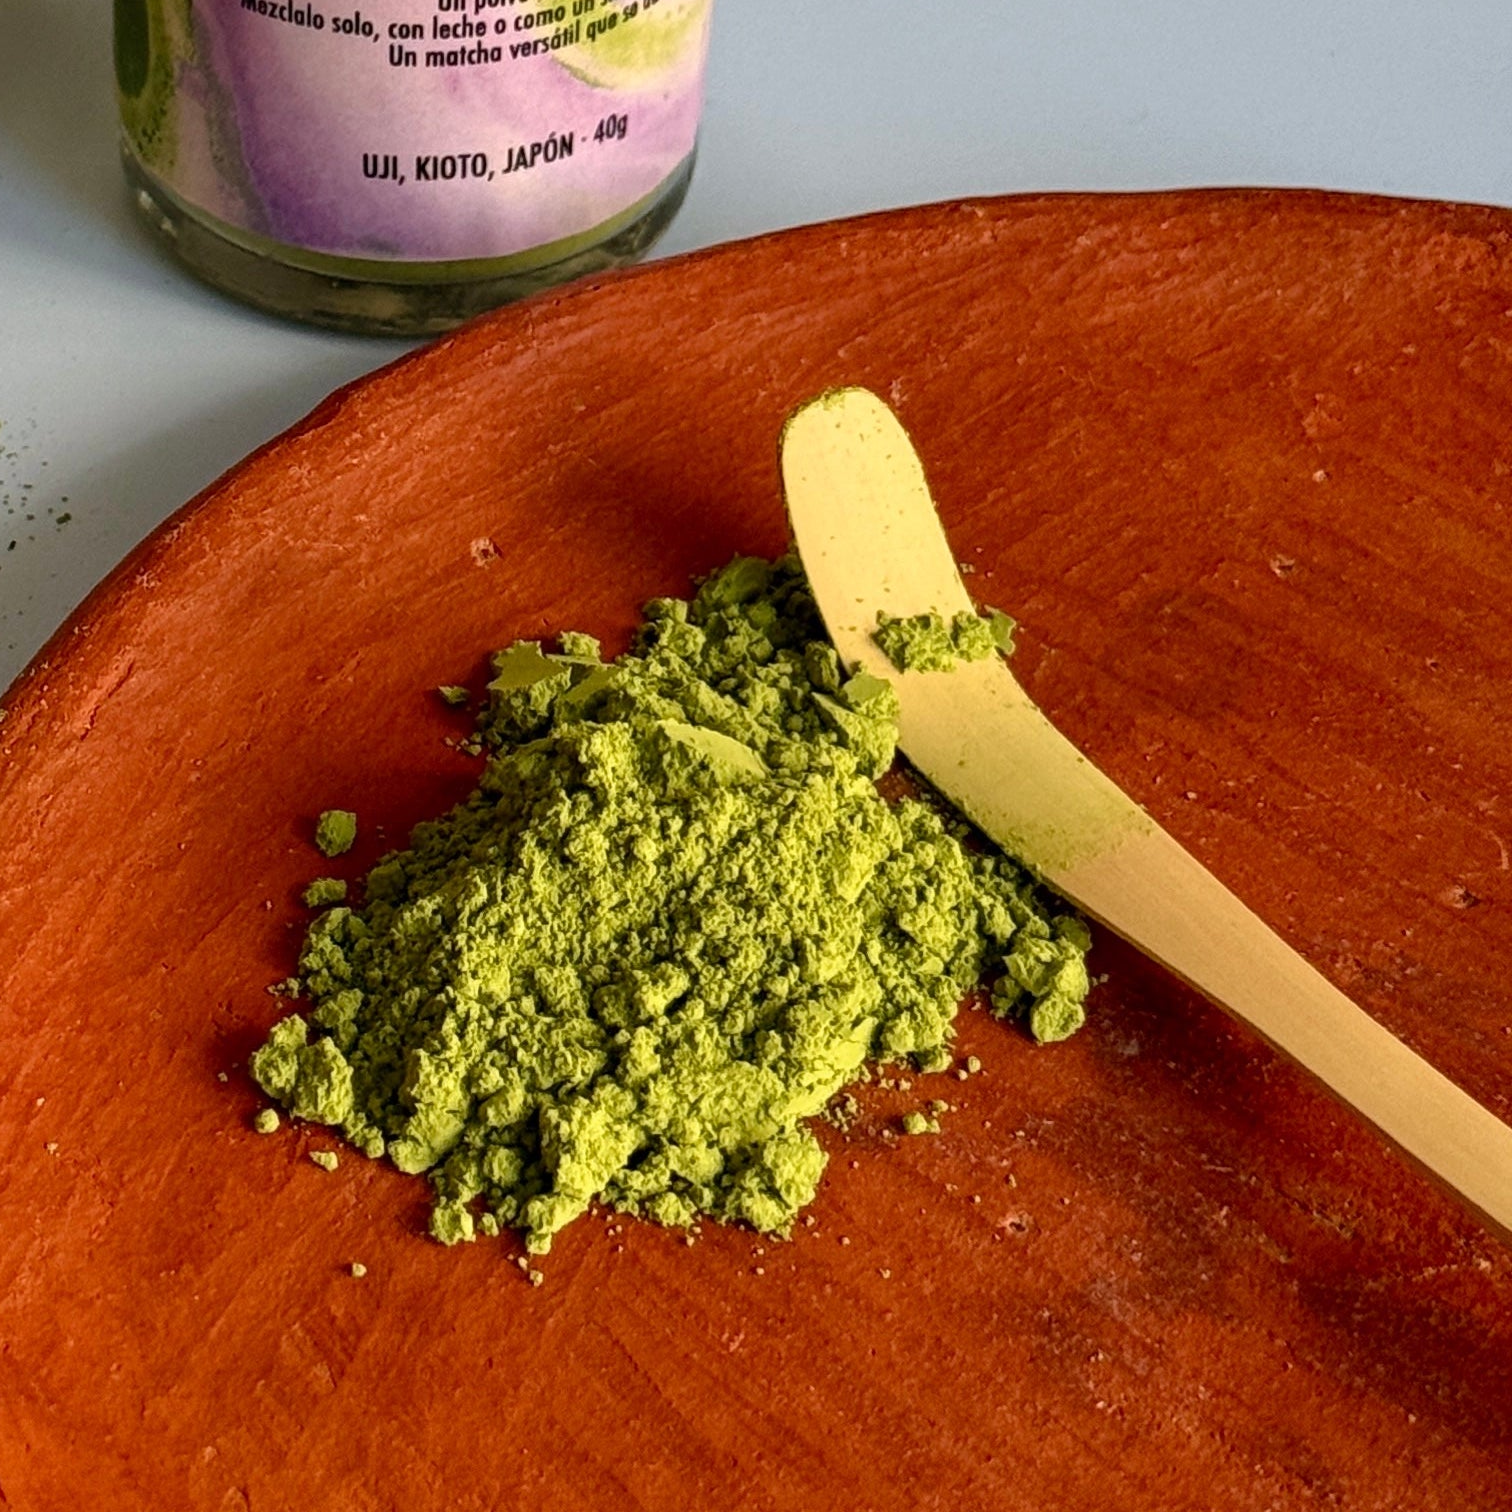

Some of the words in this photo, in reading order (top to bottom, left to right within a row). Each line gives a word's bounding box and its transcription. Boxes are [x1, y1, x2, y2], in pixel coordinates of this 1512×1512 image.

[332, 11, 380, 43] solo,
[388, 23, 424, 40] con
[432, 13, 486, 40] leche
[494, 18, 507, 35] o
[514, 5, 565, 32] como
[389, 45, 416, 68] Un
[425, 40, 502, 68] matcha
[510, 19, 580, 60] versátil
[587, 11, 617, 42] que
[622, 1, 638, 23] se
[362, 153, 405, 186] UJI,
[416, 153, 495, 182] KIOTO,
[502, 131, 574, 174] JAPÓN
[593, 114, 628, 144] 40g
